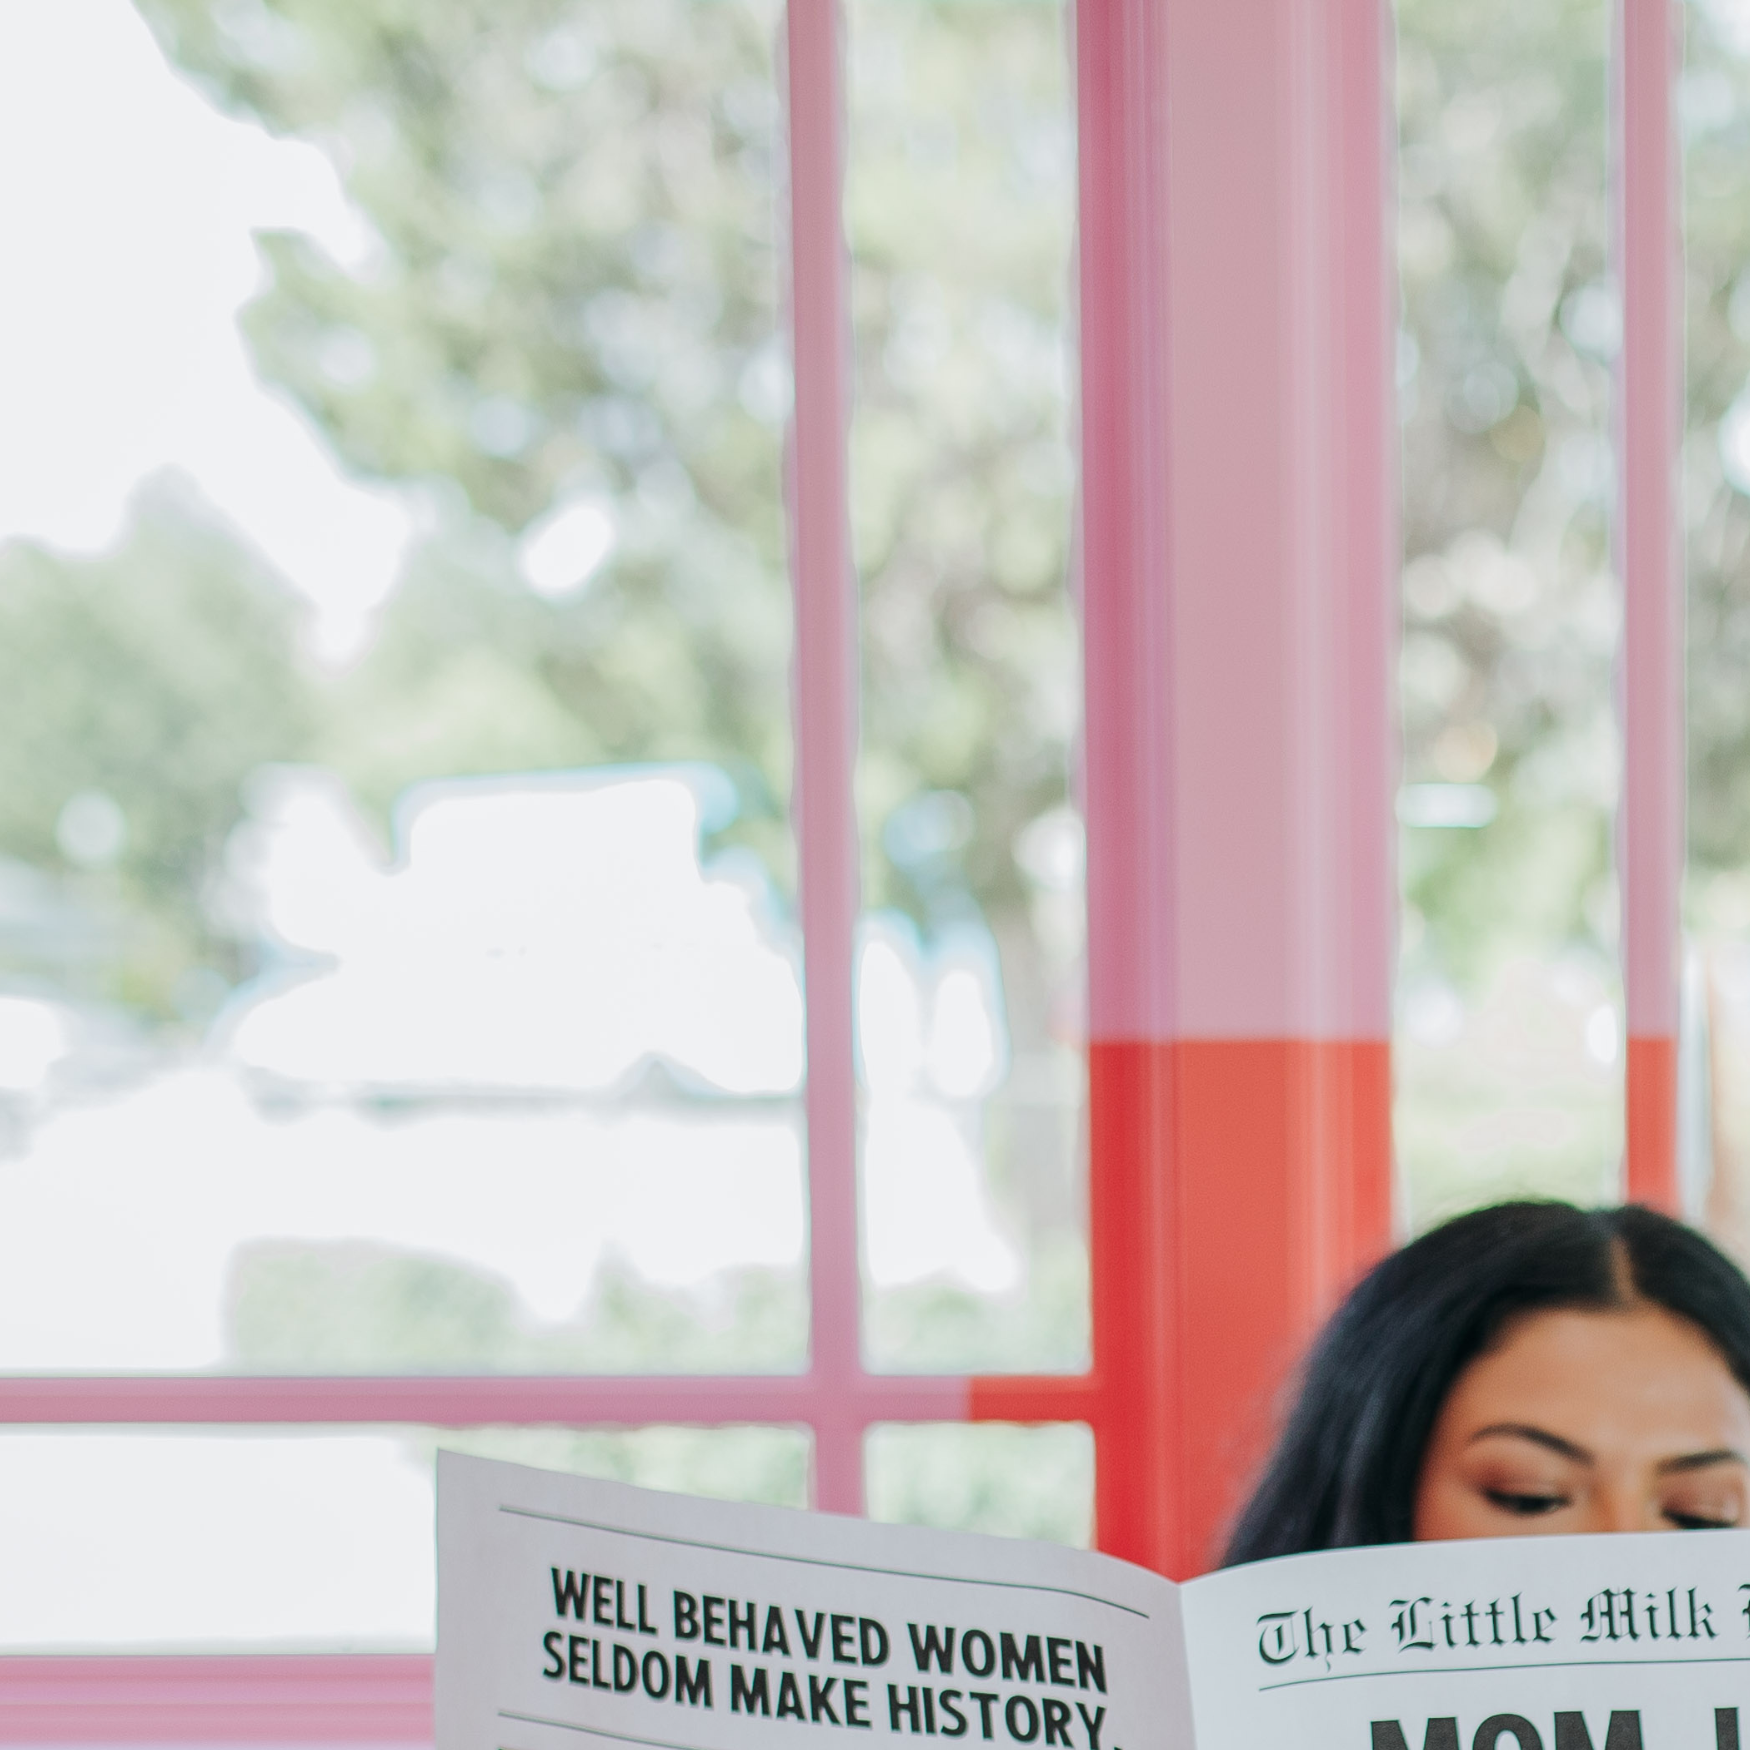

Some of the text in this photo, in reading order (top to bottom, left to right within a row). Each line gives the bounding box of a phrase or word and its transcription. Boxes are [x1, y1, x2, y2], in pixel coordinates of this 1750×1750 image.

[550, 1565, 1109, 1695] WELL BEHAVED WOMEN
[1257, 1605, 1367, 1674] The
[1390, 1590, 1558, 1655] Little
[1580, 1582, 1719, 1647] Milk
[542, 1630, 714, 1708] SELDOM
[729, 1664, 872, 1731] MAKE
